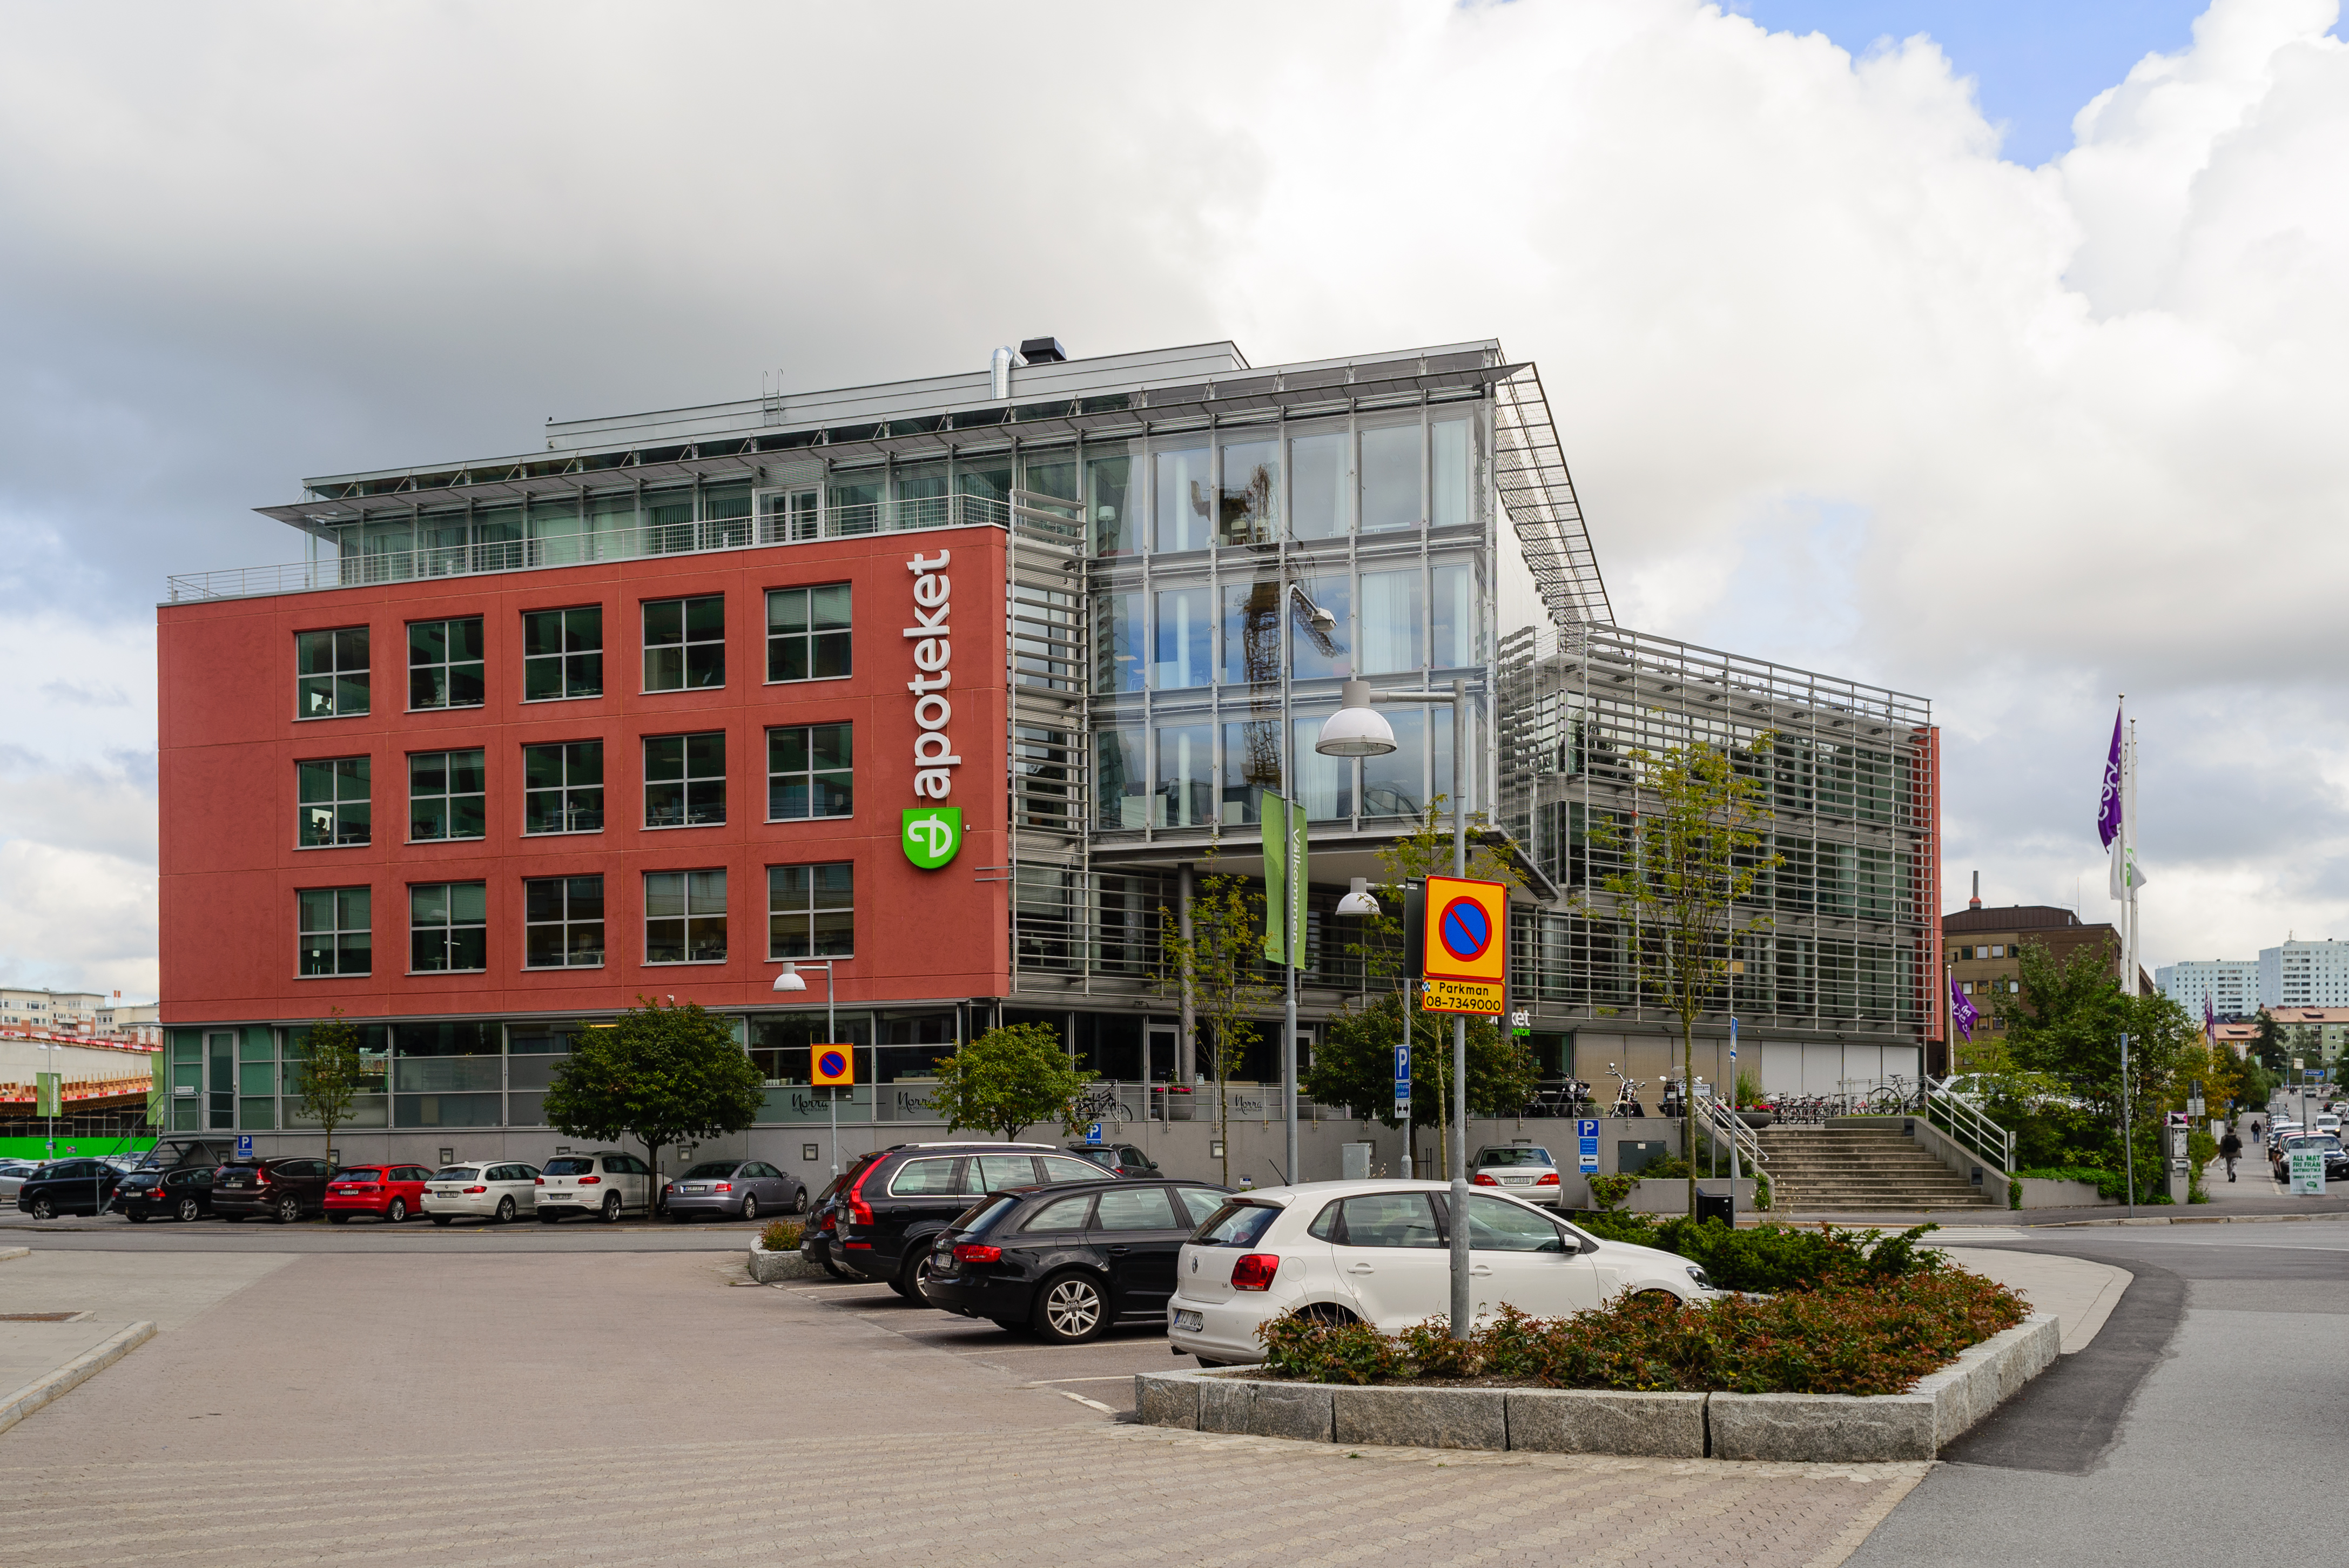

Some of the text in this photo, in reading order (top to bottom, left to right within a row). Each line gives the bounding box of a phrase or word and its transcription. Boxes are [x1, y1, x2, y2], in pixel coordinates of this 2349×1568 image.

[903, 549, 961, 799] apoteket
[1439, 982, 1489, 996] Parkman
[1426, 996, 1500, 1011] 08-7349000
[792, 1093, 829, 1115] Norra
[1235, 1094, 1263, 1115] Norra
[1177, 1311, 1203, 1327] CXJ 004
